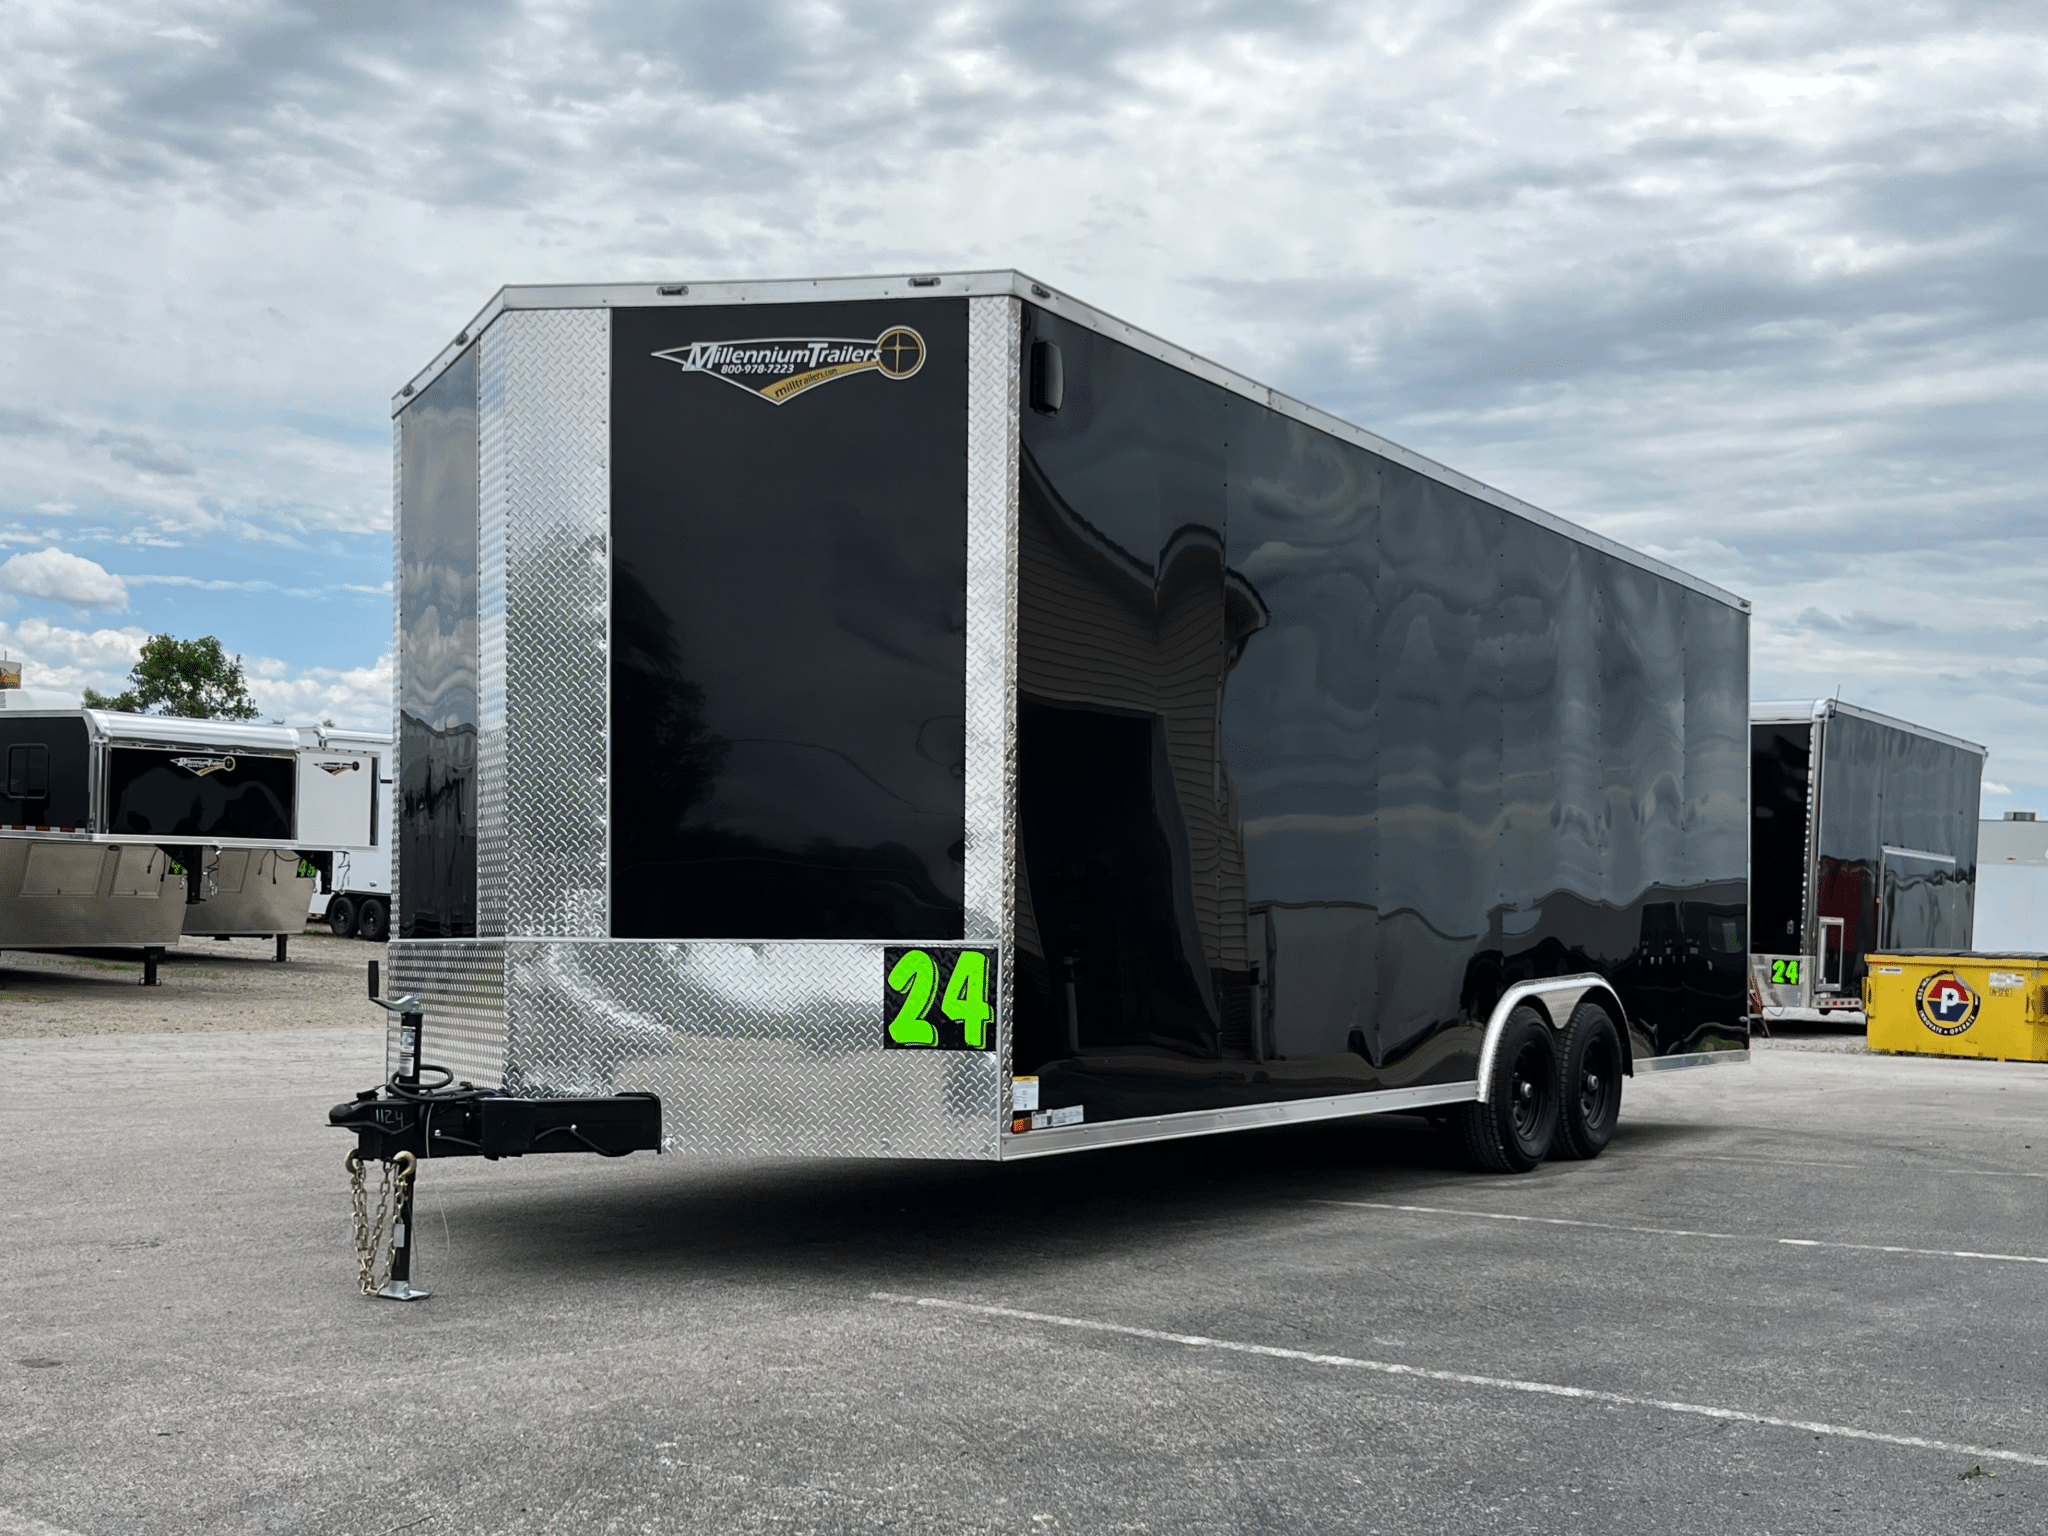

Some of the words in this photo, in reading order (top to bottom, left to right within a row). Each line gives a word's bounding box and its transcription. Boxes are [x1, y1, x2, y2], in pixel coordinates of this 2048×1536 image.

[720, 363, 795, 375] 800-978-7223
[774, 367, 838, 399] milltrailers.com
[1772, 960, 1799, 985] 24
[887, 949, 995, 1050] 24
[1940, 987, 1960, 1014] P
[1918, 1009, 1943, 1034] INNOVATE
[1949, 1015, 1976, 1035] OPERATE
[375, 1108, 403, 1128] 1124
